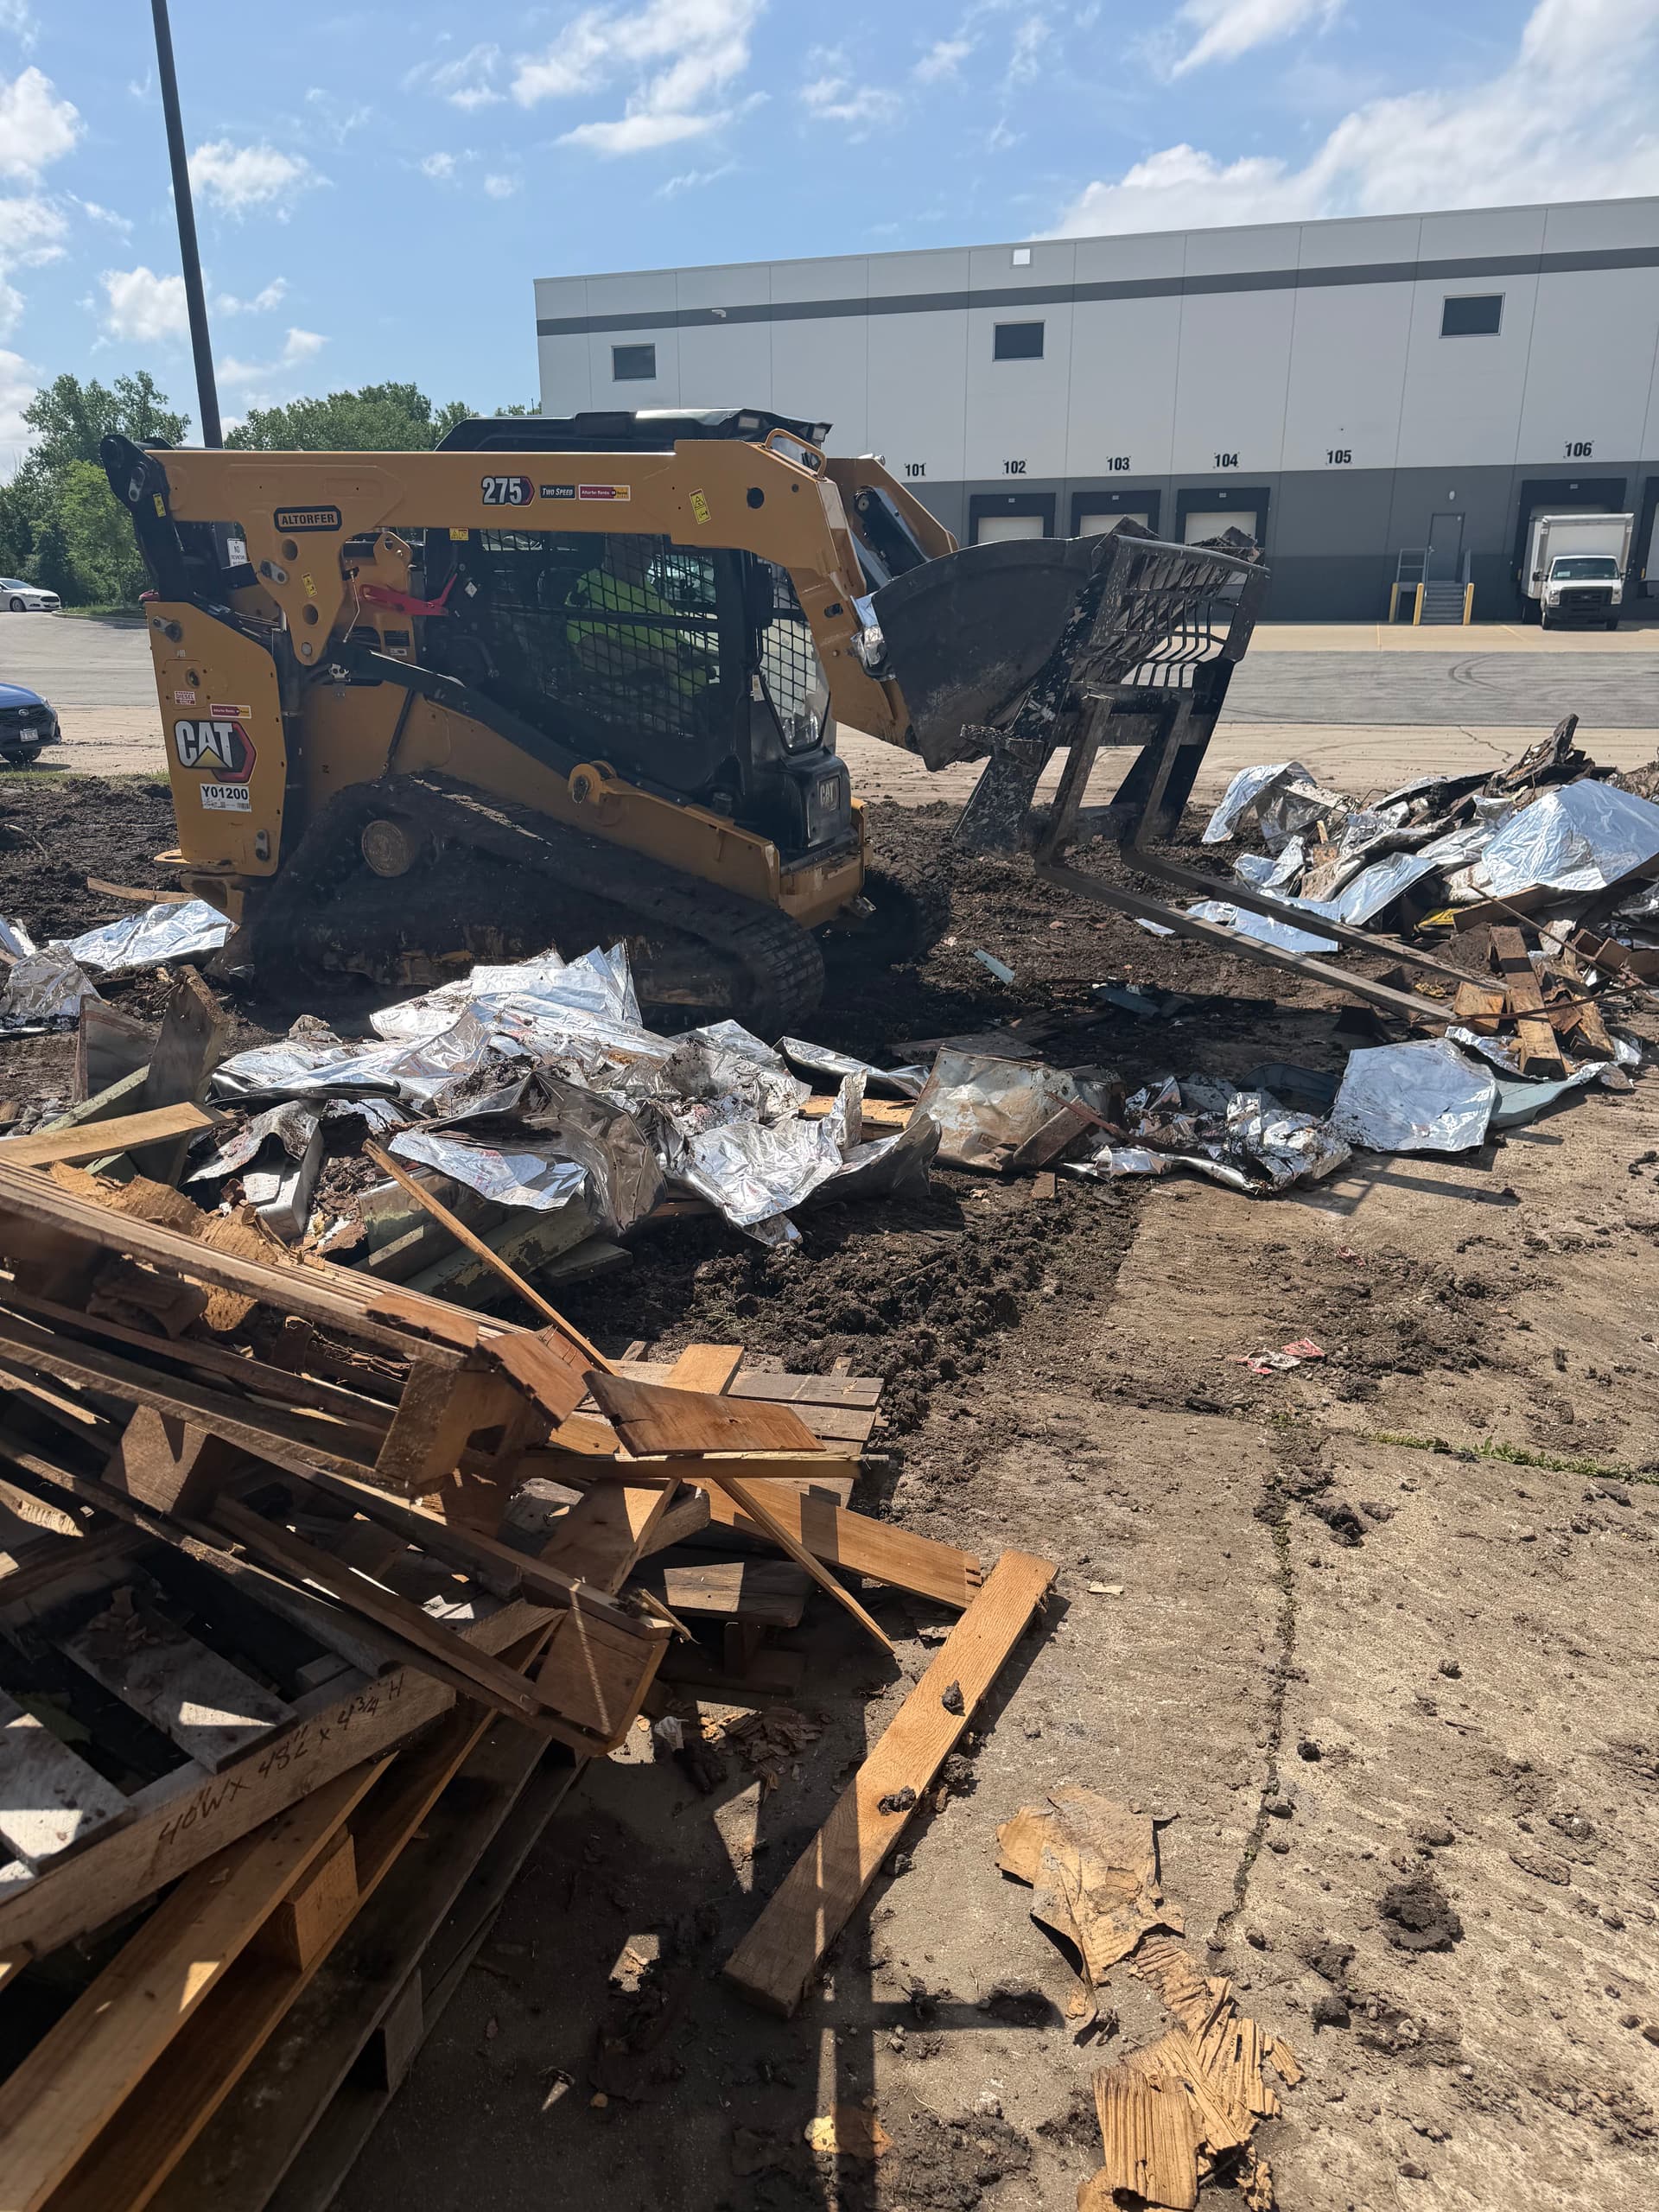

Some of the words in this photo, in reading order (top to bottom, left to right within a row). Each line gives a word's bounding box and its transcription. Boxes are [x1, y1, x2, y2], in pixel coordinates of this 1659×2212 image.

[1327, 449, 1351, 464] 105
[1565, 442, 1592, 457] 106
[1003, 461, 1027, 474] 102
[1107, 457, 1130, 471] 103
[1214, 453, 1238, 467] 104
[905, 463, 925, 476] 101
[481, 477, 522, 504] 275
[282, 513, 334, 525] ALTORFER
[175, 721, 233, 768] CAT
[201, 785, 249, 800] Y01200
[819, 781, 835, 804] CAT
